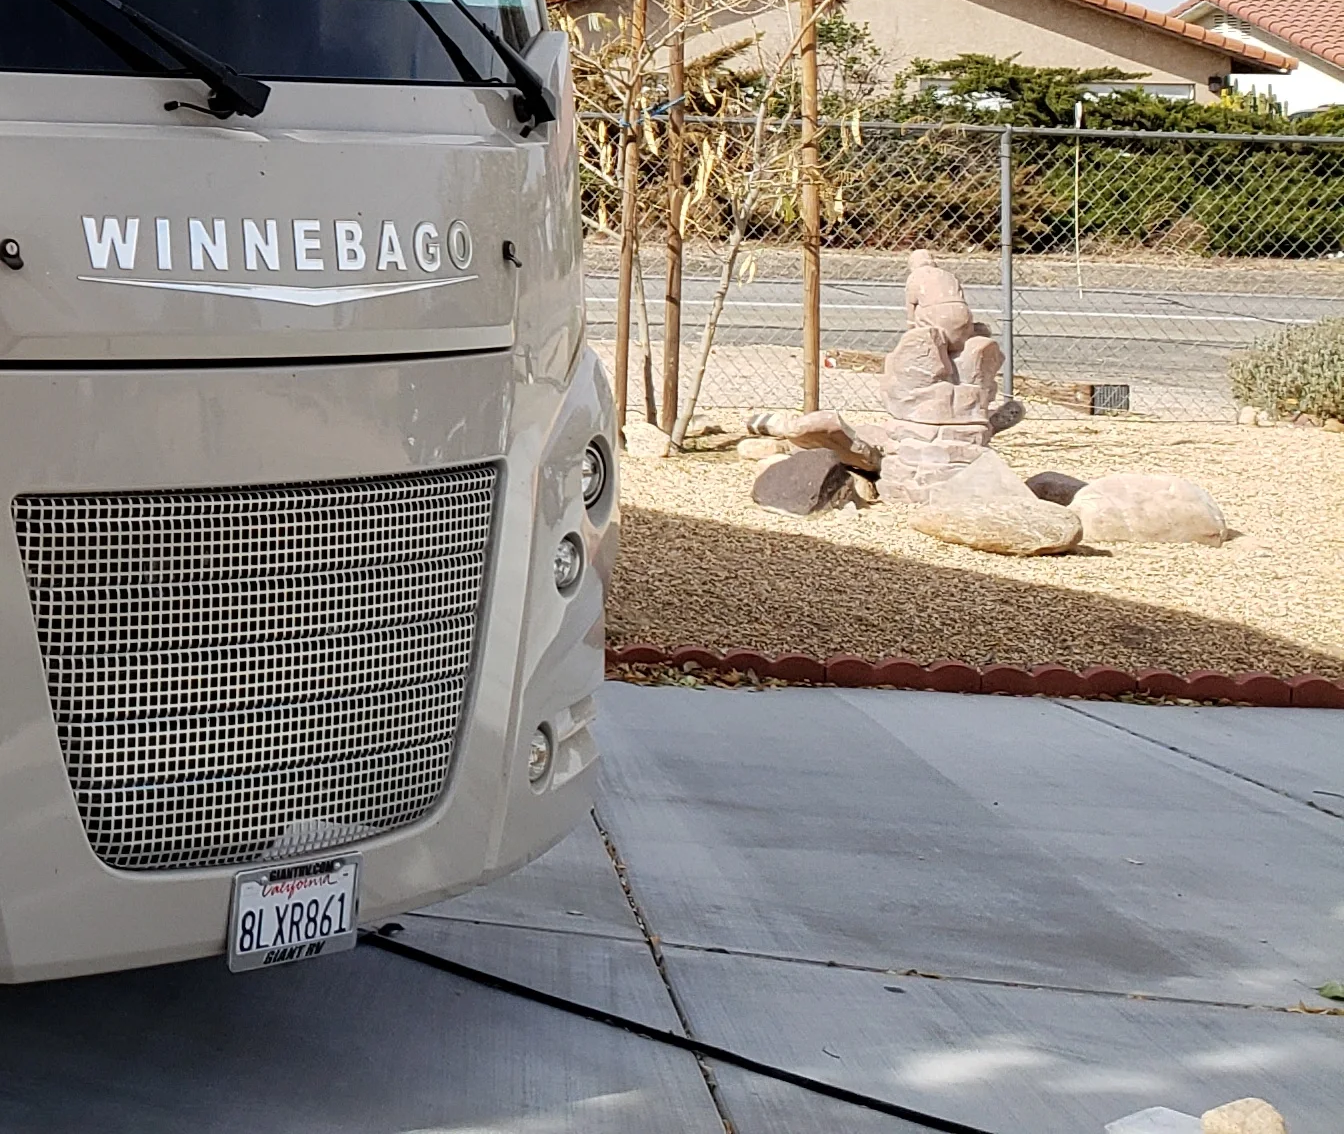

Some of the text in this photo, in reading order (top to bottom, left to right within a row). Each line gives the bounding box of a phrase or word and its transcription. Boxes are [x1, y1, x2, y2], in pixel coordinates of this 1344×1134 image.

[80, 215, 474, 271] WINNEBAGO
[262, 874, 338, 900] California
[239, 892, 346, 952] 8LXR861
[263, 940, 326, 965] GIANT RV
